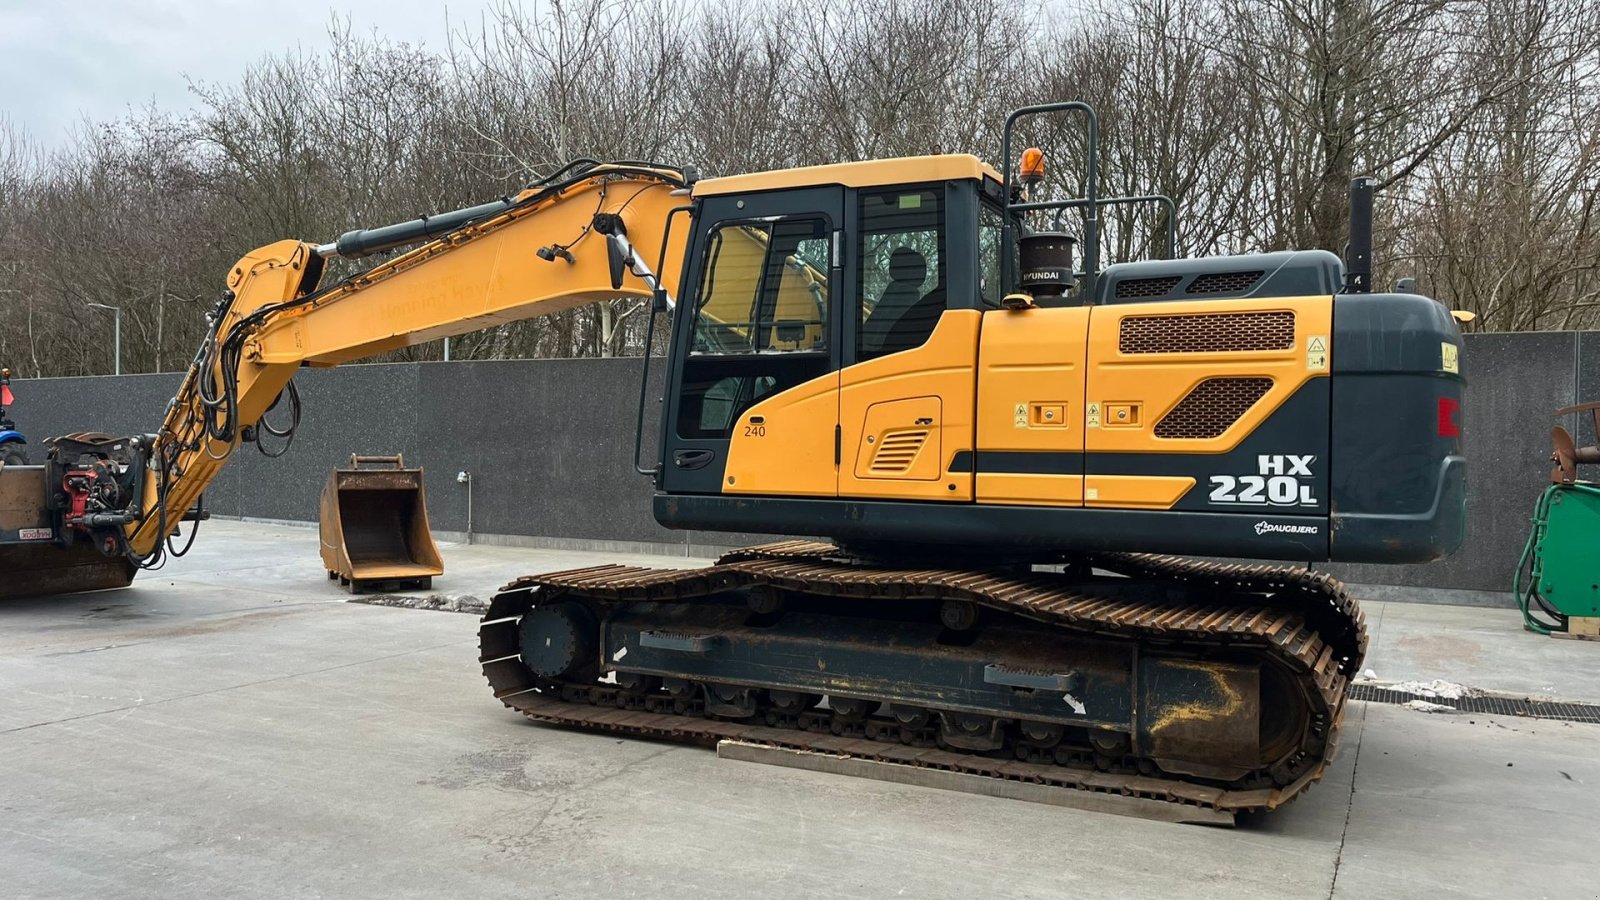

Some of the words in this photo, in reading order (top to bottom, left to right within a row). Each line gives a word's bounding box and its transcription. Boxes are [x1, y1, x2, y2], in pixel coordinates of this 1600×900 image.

[1023, 272, 1059, 280] HYUNDAI
[745, 426, 765, 437] 240
[1258, 455, 1315, 475] HX
[1208, 475, 1318, 504] 220L
[1267, 524, 1318, 534] DAUGBJERG
